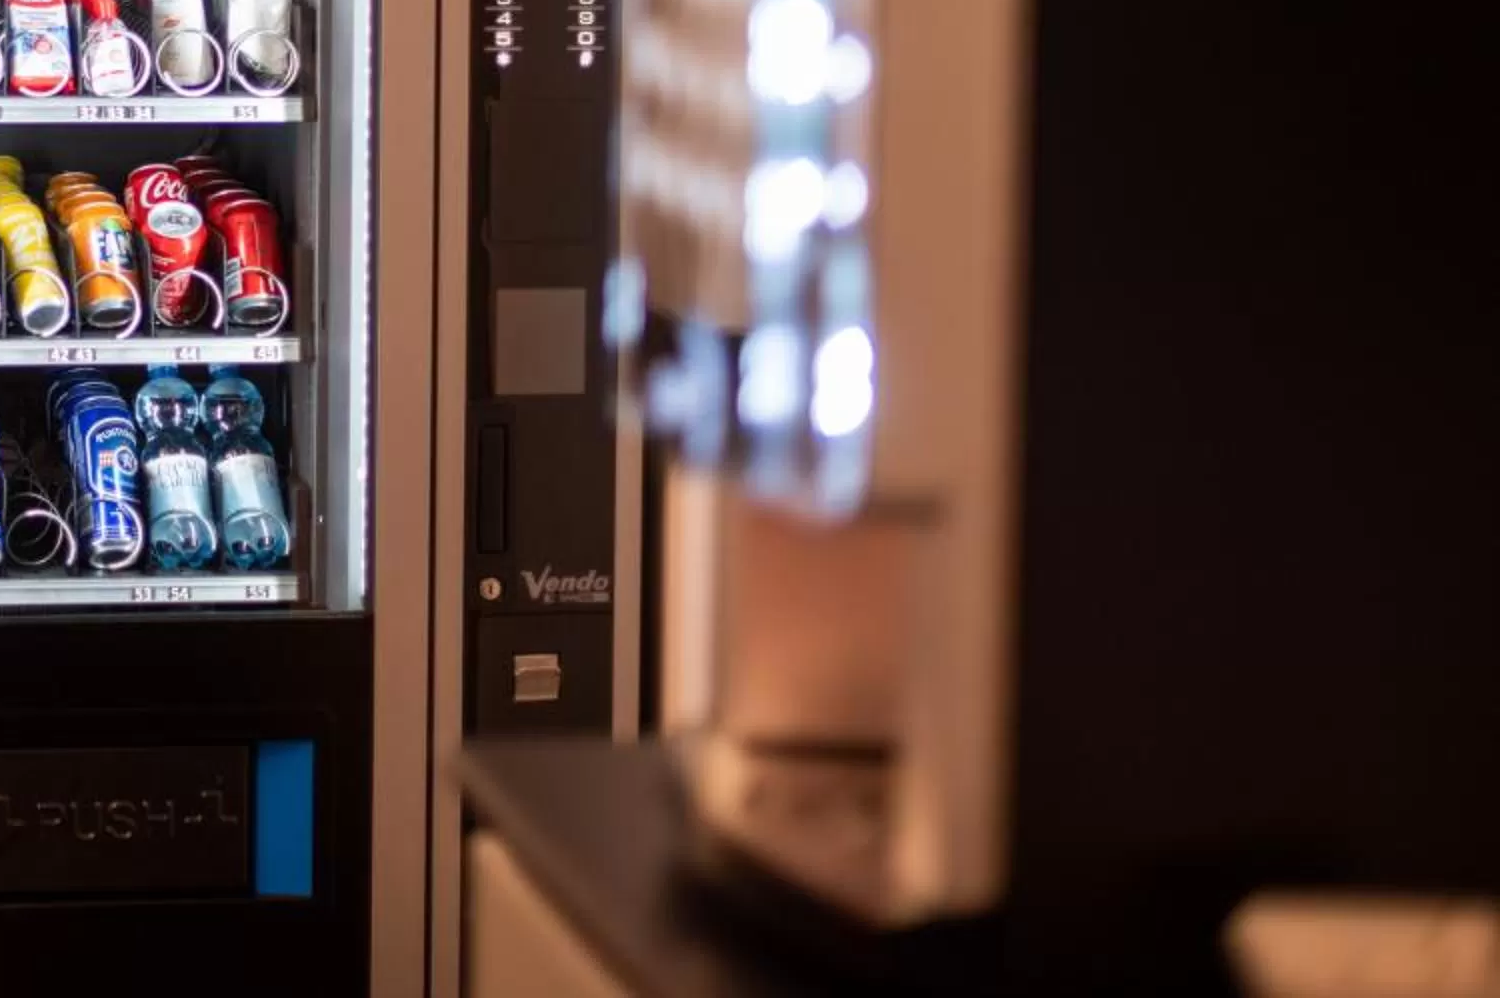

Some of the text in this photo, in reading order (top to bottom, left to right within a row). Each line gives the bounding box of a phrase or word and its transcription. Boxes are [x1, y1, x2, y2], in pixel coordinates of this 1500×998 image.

[496, 11, 512, 25] 4
[495, 31, 512, 46] 5
[578, 31, 595, 45] 0
[520, 565, 609, 599] Vendo
[37, 800, 175, 840] PUSH
